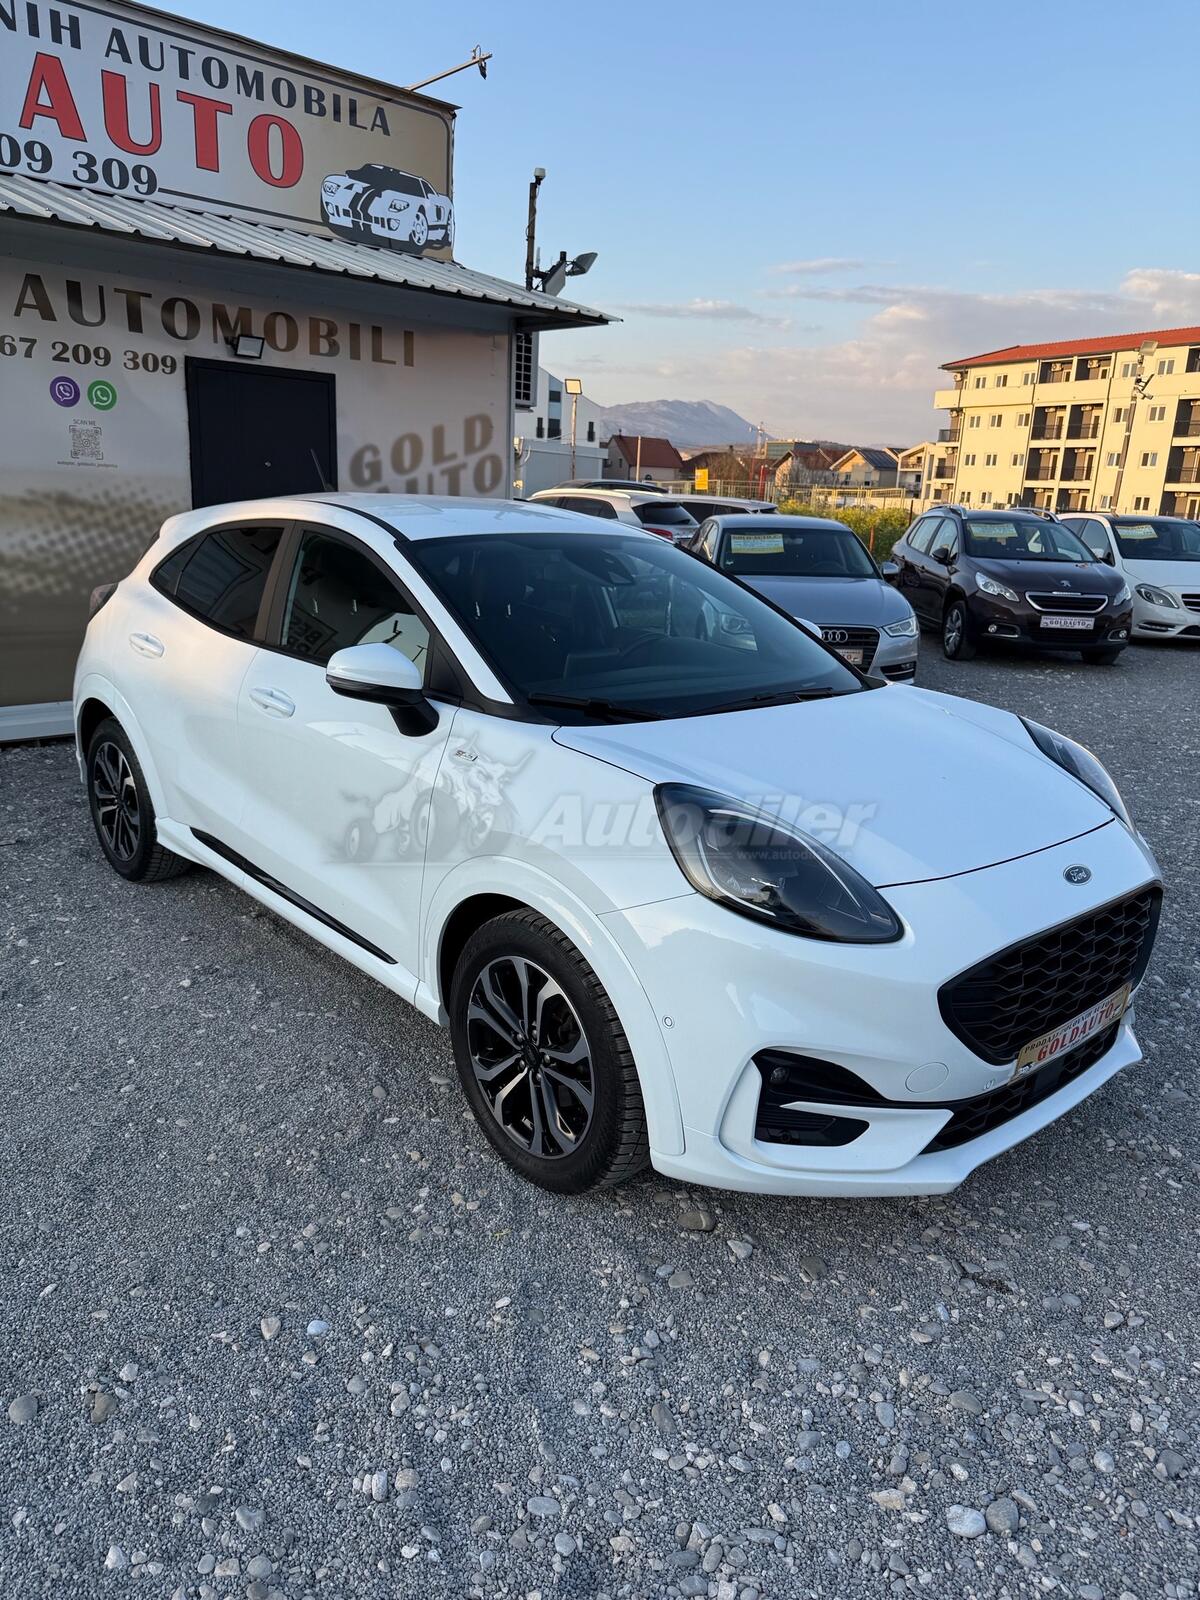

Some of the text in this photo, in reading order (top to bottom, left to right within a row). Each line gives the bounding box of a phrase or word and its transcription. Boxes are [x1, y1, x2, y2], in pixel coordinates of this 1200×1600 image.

[104, 27, 391, 136] AUTOMOBILA
[19, 51, 304, 188] AUTO
[0, 133, 158, 196] 09 309
[14, 273, 414, 367] AUTOMOBILI
[0, 334, 177, 375] 67 209 309
[350, 413, 493, 487] GOLD
[376, 453, 503, 496] TO
[1038, 1001, 1114, 1062] GOLDAUTO
